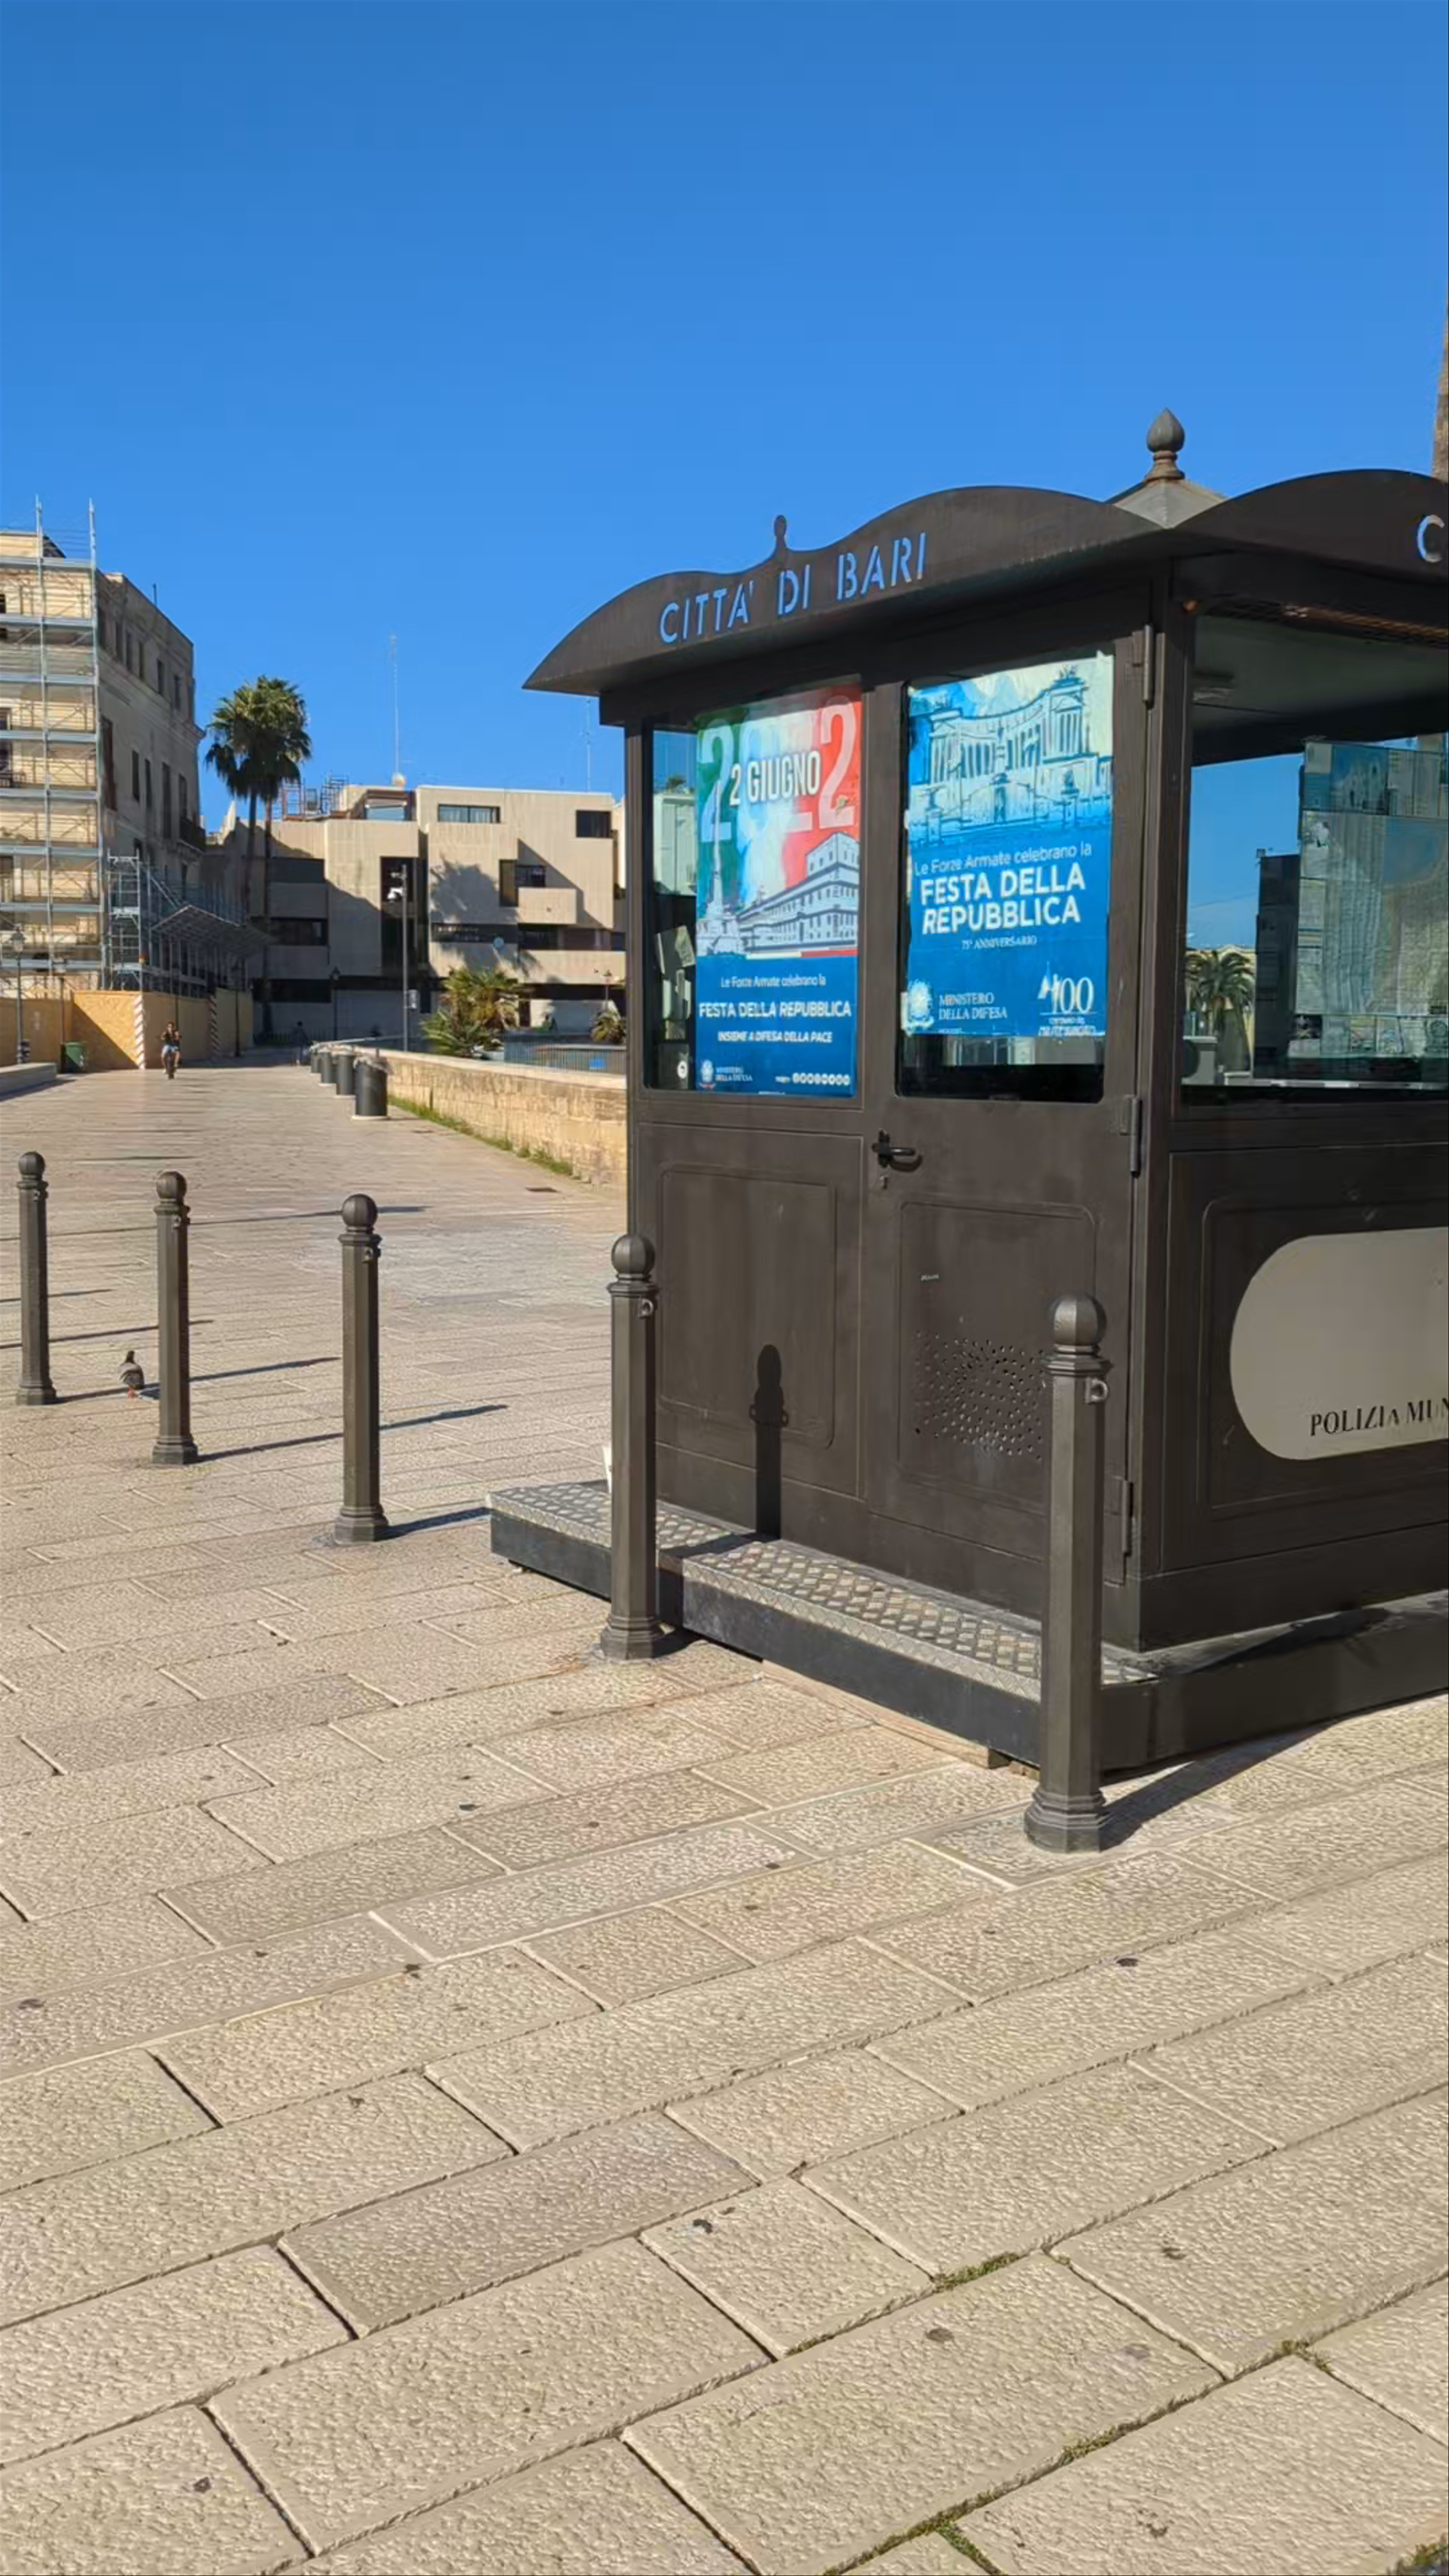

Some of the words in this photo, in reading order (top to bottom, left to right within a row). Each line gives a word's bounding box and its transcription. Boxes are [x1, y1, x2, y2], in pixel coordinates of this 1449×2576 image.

[659, 580, 754, 643] CITTA'
[778, 564, 811, 615] DI
[836, 532, 926, 600] BARI
[729, 765, 742, 806] 2
[748, 751, 821, 804] GIUGNO
[915, 862, 928, 876] Le
[931, 857, 962, 874] Forze
[965, 850, 1011, 869] Armate
[1014, 844, 1076, 863] celebrano
[1080, 841, 1092, 857] la
[920, 873, 992, 906] FESTA
[1000, 863, 1086, 898] DELLA
[922, 895, 1081, 935] REPUBBLICA
[974, 935, 1037, 949] ANNIVERSARIO
[699, 1002, 736, 1017] FESTA
[738, 1001, 776, 1017] DELLA
[780, 1000, 852, 1017] REPUBBLICA
[938, 992, 994, 1006] MINISTERO
[938, 1007, 970, 1020] DELLA
[972, 1007, 1008, 1019] DIFESA
[784, 1031, 810, 1042] DELLA
[811, 1032, 832, 1043] PACE
[1311, 1405, 1400, 1436] POLIZIA
